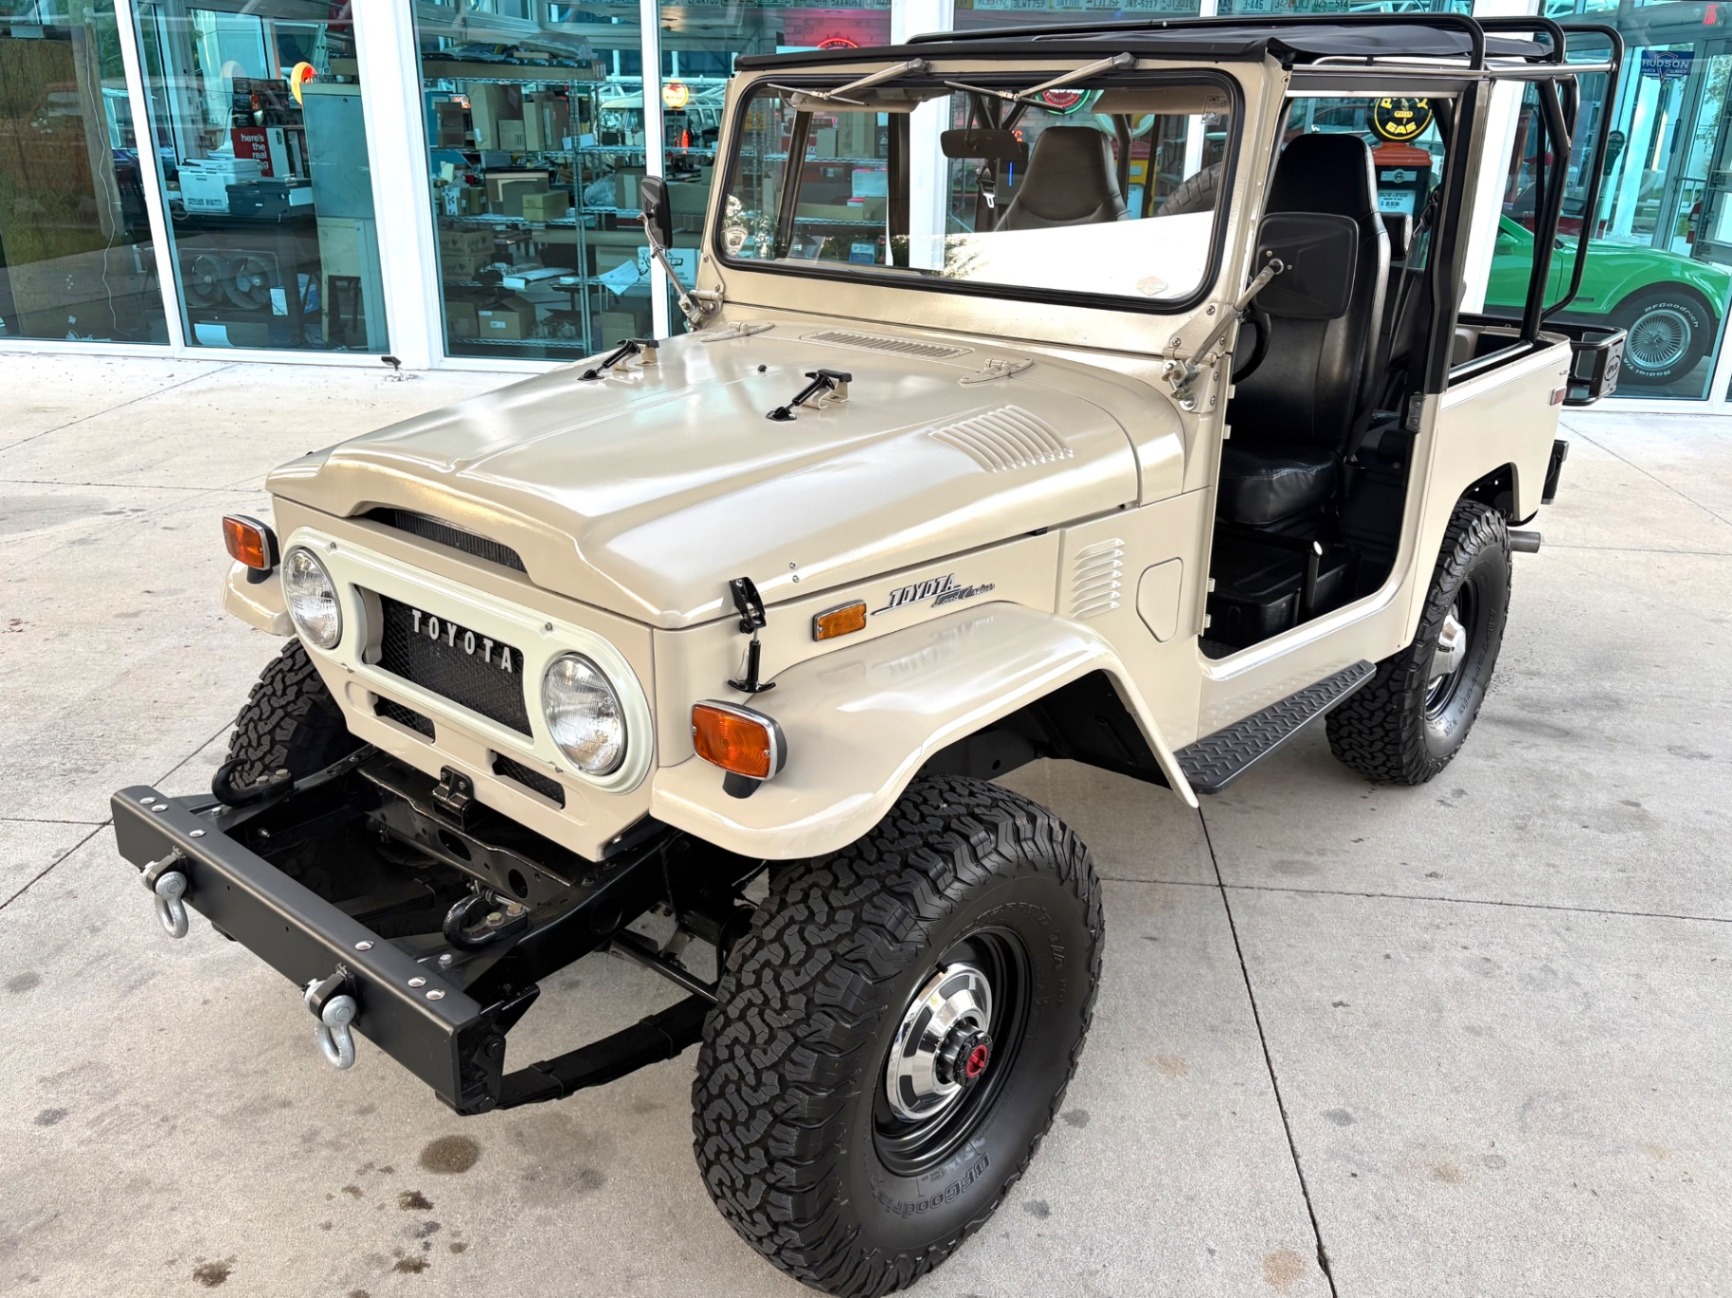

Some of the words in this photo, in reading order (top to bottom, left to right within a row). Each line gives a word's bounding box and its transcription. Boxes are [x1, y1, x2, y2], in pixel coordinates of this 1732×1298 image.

[1642, 59, 1690, 68] HUDSON
[1385, 121, 1417, 134] GAS
[240, 133, 265, 142] here's
[252, 142, 266, 151] the
[252, 151, 268, 159] real
[889, 573, 957, 608] TOYOTA
[411, 608, 513, 673] TOYOTA
